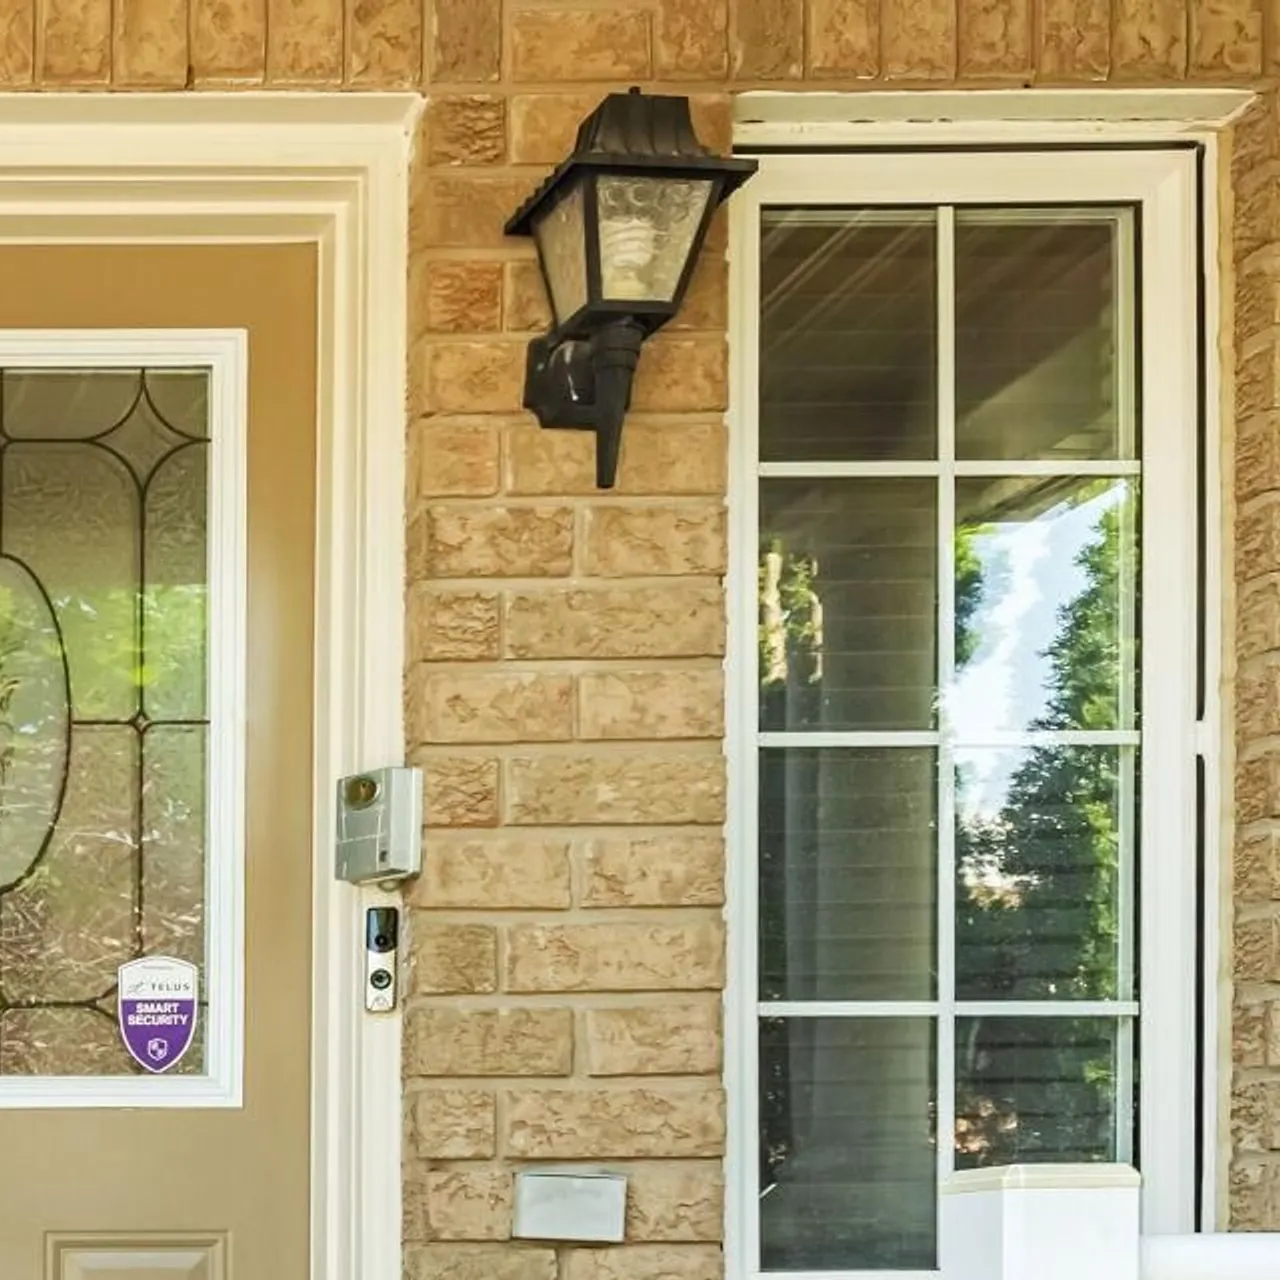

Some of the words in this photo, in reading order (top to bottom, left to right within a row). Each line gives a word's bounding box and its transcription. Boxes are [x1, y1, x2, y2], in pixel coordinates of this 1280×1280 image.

[151, 982, 190, 991] TELUS
[136, 1002, 180, 1013] SMART
[127, 1014, 189, 1025] SECURITY
